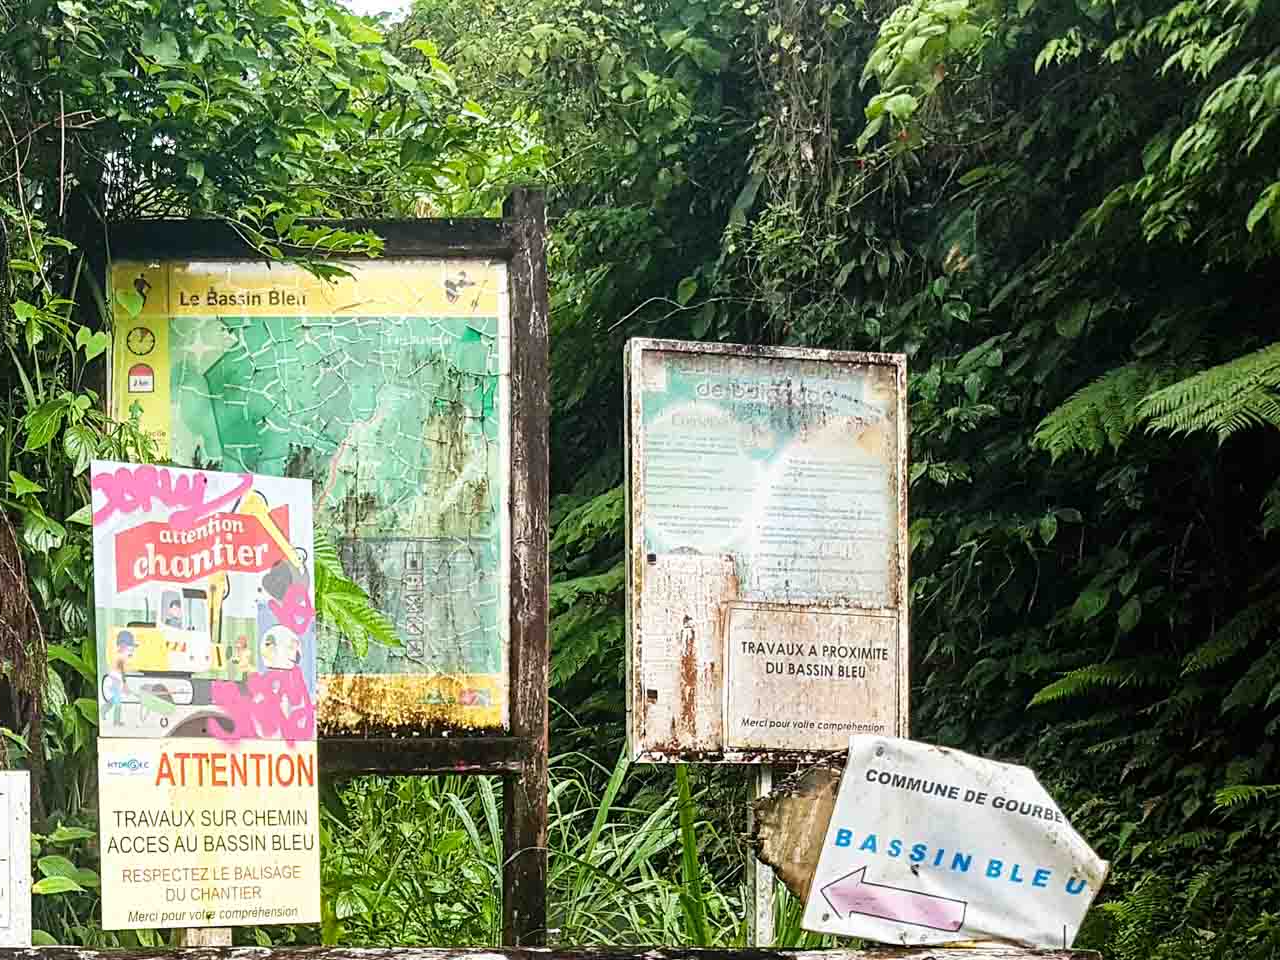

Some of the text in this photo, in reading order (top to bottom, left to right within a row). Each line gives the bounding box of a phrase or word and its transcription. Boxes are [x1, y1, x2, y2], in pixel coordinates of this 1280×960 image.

[180, 291, 200, 306] Le
[208, 290, 261, 306] Bassin
[133, 533, 269, 580] chantier
[741, 641, 889, 661] TRAVAUX A PROXIMITE
[766, 662, 866, 679] DU BASSIN BLEU
[740, 718, 768, 728] Merci
[769, 719, 790, 730] pour
[155, 752, 315, 787] ATTENTION
[865, 768, 1063, 824] COMMUNE DE GOURBE
[112, 809, 308, 828] TRAVAUX SUR CHEMIN
[107, 833, 314, 854] ACCES AU BASSIN BLEU
[835, 828, 1087, 896] BASSIN BLEU
[122, 865, 302, 884] RESPECTEZ LE BALISAGE
[166, 886, 262, 902] DU CHANTIER
[128, 911, 158, 924] Merci
[161, 912, 185, 924] pour
[219, 907, 299, 921] compréhension
